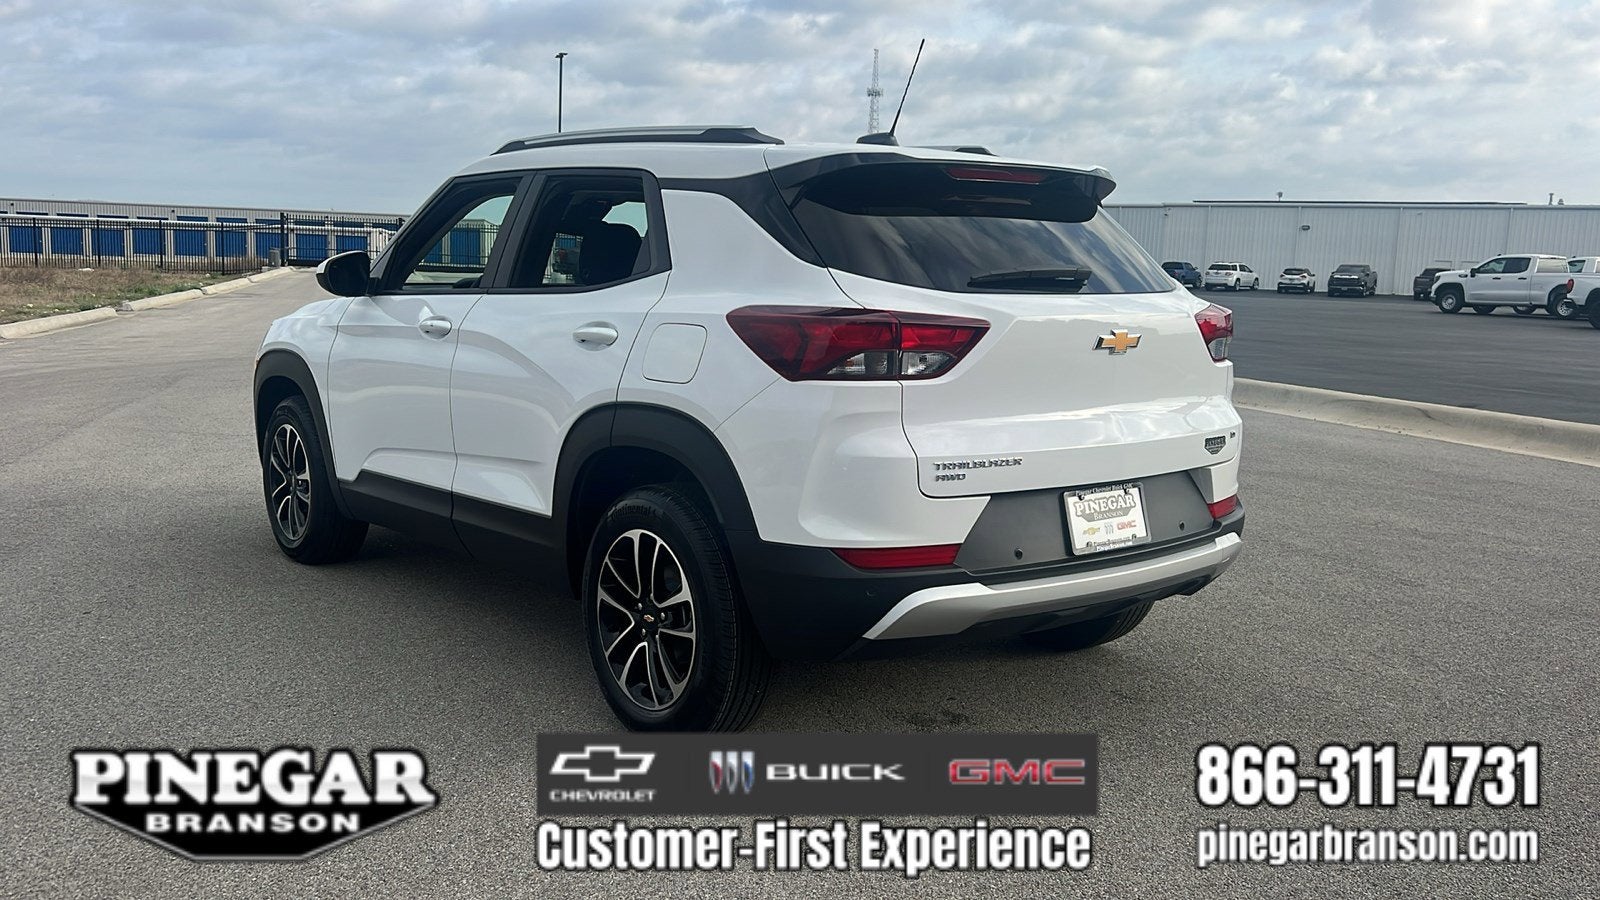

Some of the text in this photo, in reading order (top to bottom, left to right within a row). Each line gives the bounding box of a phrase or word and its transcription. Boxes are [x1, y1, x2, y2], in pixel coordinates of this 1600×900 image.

[933, 457, 1023, 470] TRAILBLAZER
[935, 473, 966, 482] AWD
[1074, 494, 1135, 516] PINEGAR
[1094, 511, 1123, 521] BRANSON
[1117, 520, 1137, 530] GMC
